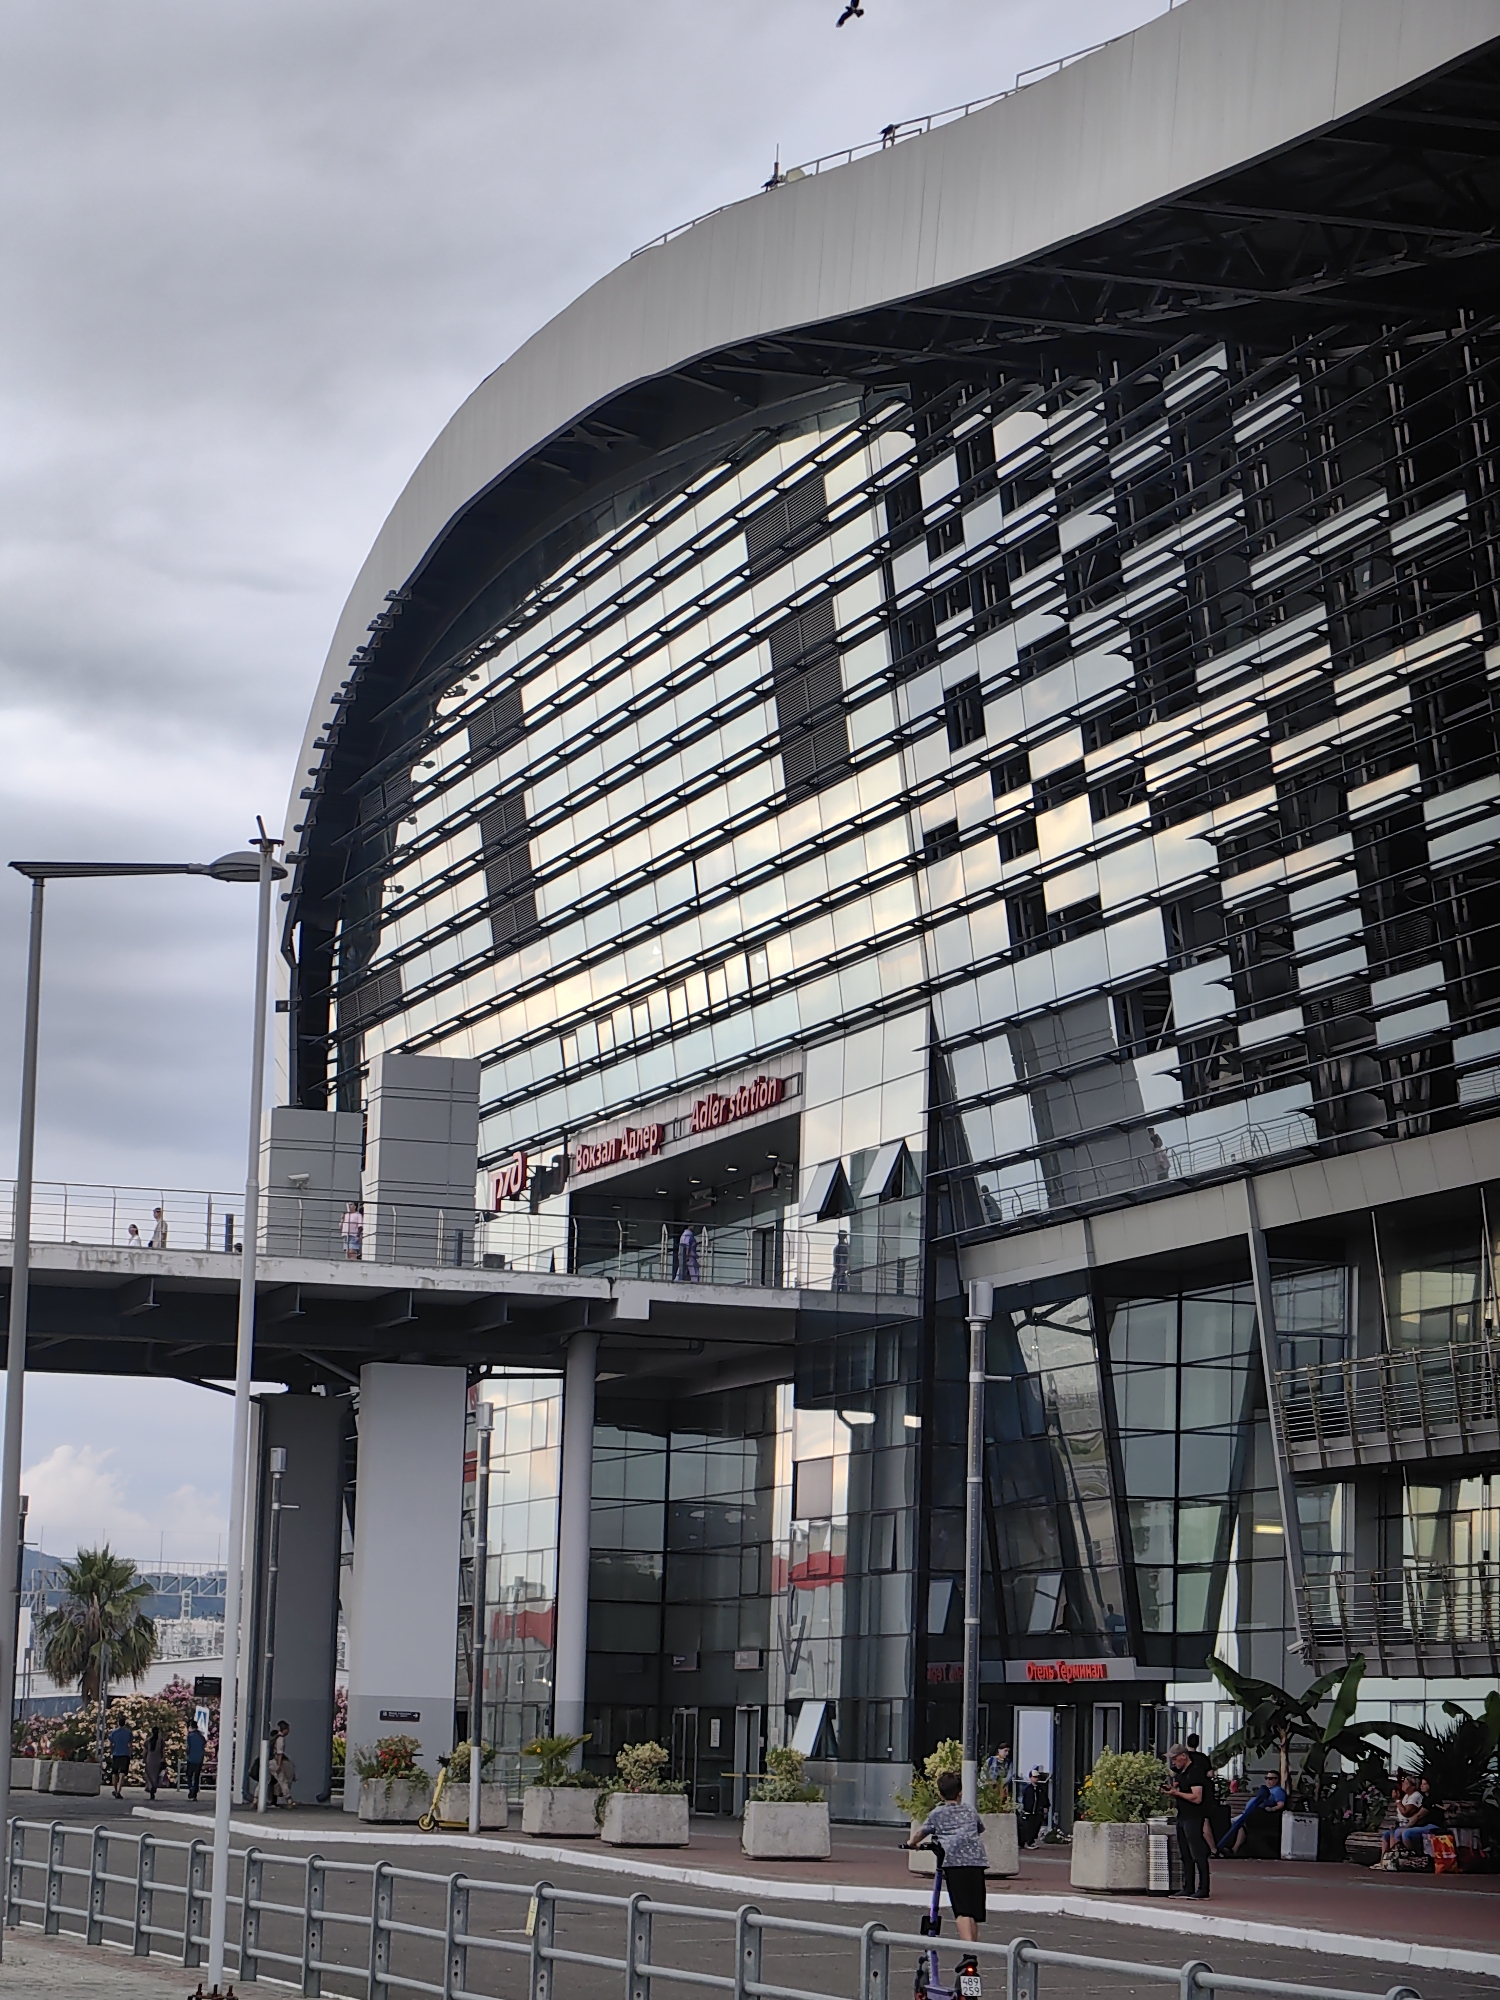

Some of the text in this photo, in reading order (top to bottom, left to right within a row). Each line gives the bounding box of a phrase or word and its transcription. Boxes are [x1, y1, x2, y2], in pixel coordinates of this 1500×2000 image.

[690, 1076, 778, 1132] Adler station
[575, 1123, 661, 1173] Вокзал Адлер
[1026, 1660, 1106, 1684] Отель Терминал
[962, 1977, 979, 1986] 489
[963, 1986, 980, 1996] 259
